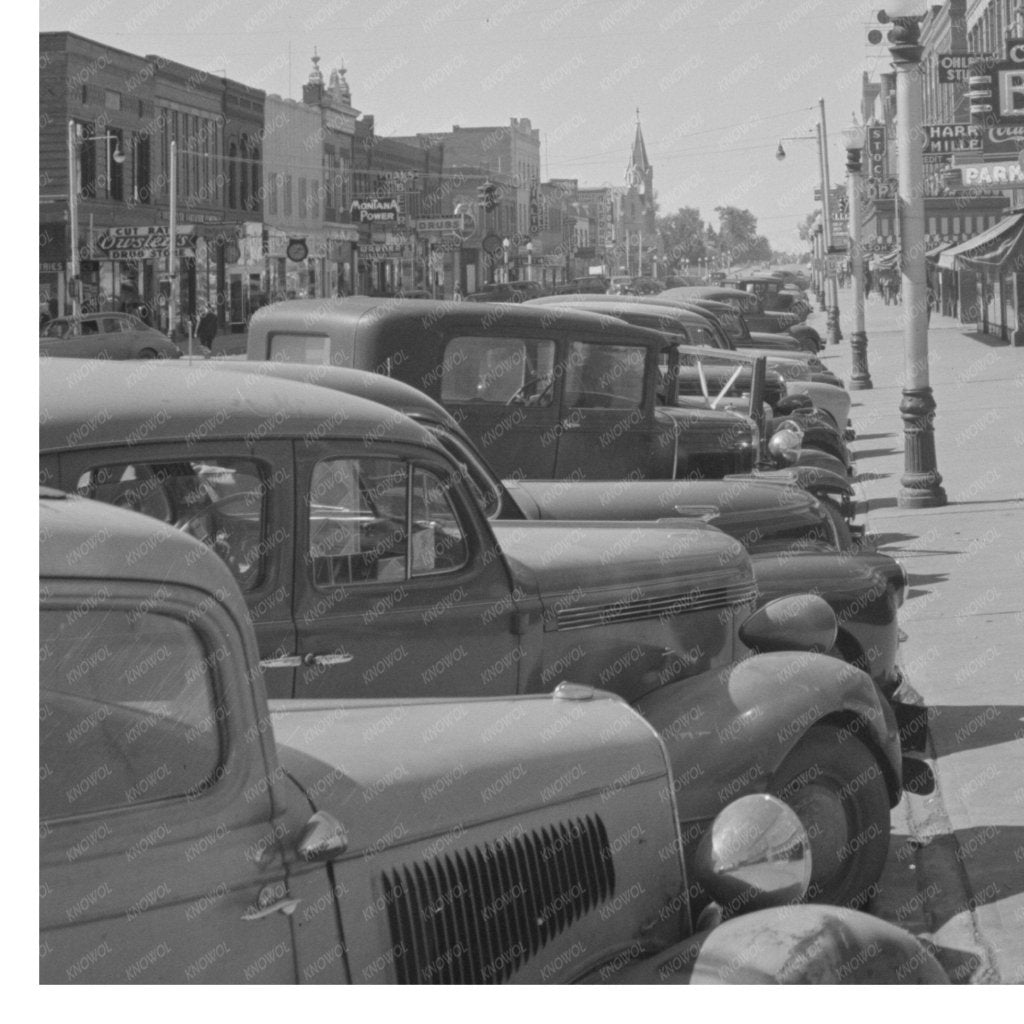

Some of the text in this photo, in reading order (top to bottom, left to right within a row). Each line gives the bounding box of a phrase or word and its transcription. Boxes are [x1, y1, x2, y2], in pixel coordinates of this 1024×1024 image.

[966, 165, 1024, 185] PARK
[349, 198, 400, 214] MONTANA
[360, 210, 395, 223] POWER
[418, 220, 461, 229] DRUGS
[116, 227, 171, 235] CUT RAT
[112, 250, 144, 258] DRUG
